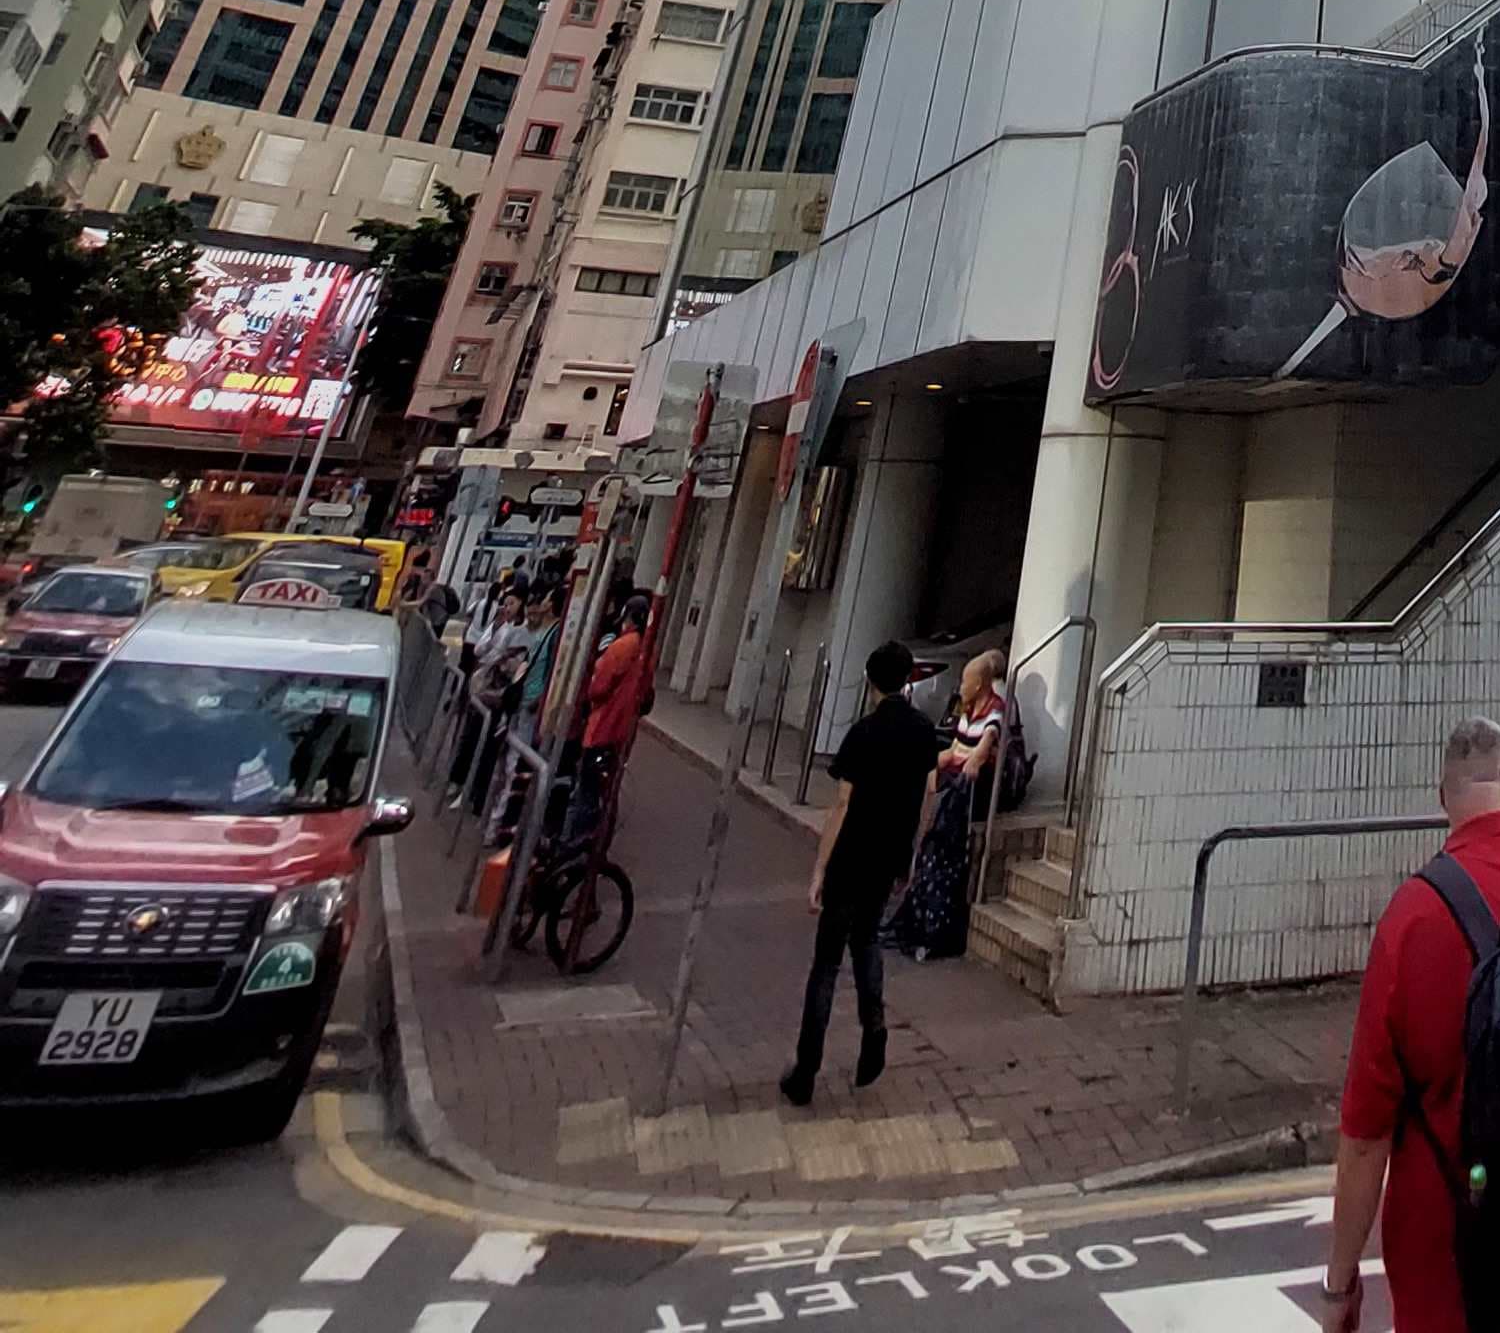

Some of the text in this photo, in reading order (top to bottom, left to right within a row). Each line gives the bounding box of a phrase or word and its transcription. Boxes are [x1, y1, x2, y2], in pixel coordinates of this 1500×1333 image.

[256, 580, 321, 603] TAXI
[87, 997, 134, 1028] YU
[47, 1030, 139, 1061] 2928
[647, 1231, 1208, 1333] LOOK LEFT
